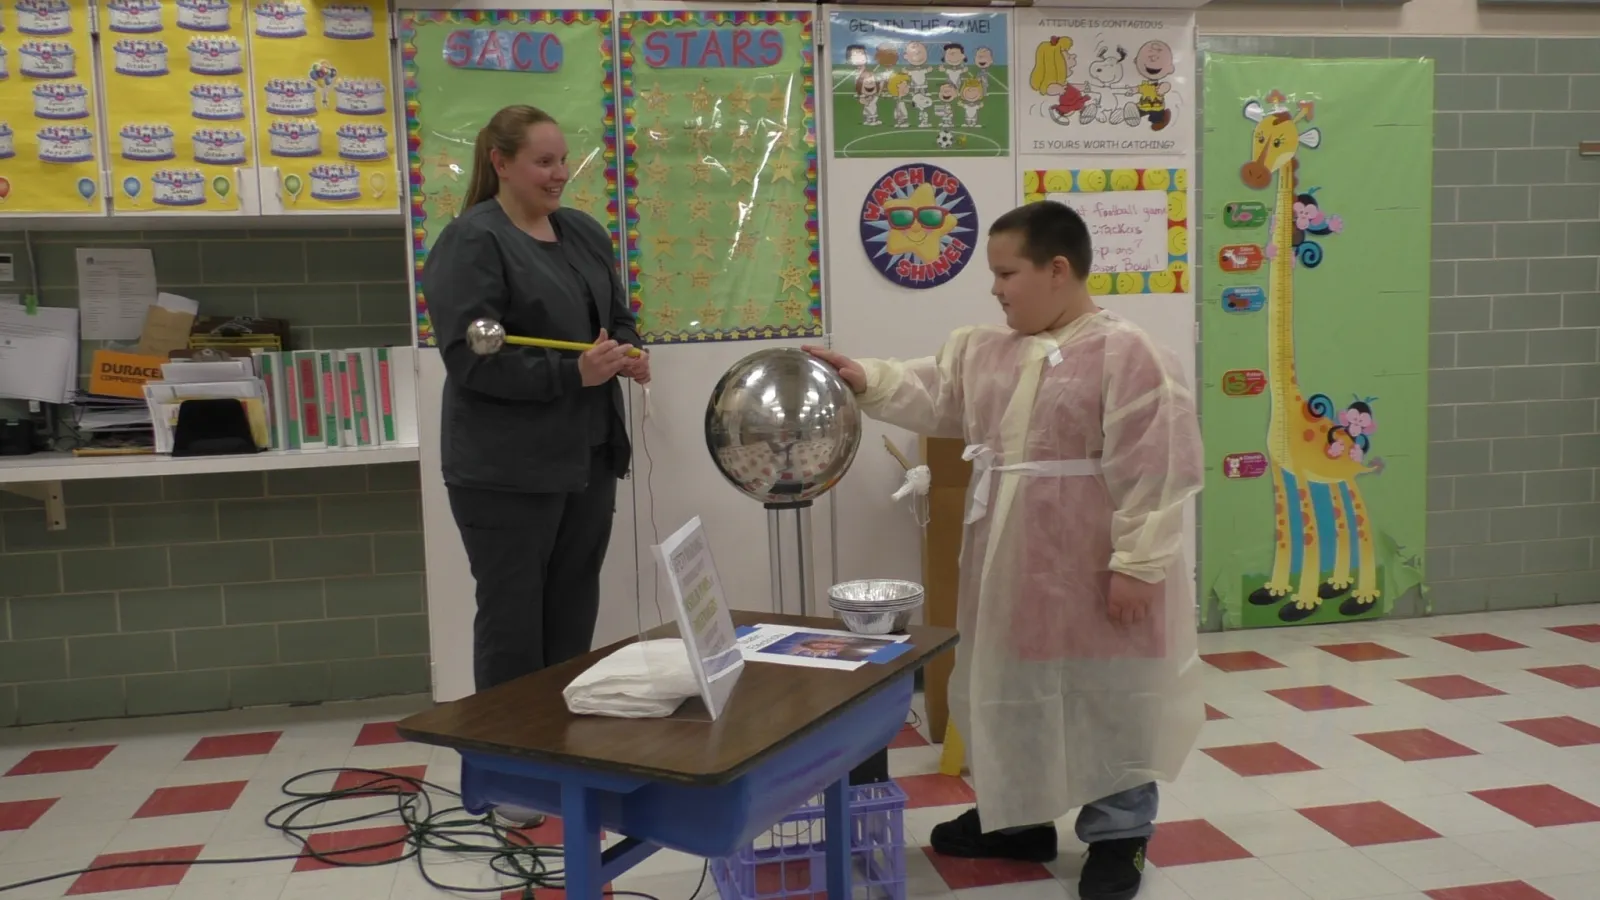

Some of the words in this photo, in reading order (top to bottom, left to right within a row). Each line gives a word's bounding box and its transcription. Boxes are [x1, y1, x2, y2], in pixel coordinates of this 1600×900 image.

[849, 19, 877, 32] GET
[884, 19, 904, 31] IN
[910, 19, 940, 32] THE
[947, 19, 991, 34] GAME!
[1039, 18, 1086, 28] ATTITUDE
[1088, 19, 1100, 28] IS
[1101, 19, 1164, 30] CONTAGIOUS
[446, 29, 561, 71] SACC
[644, 29, 784, 68] STARS
[1033, 140, 1045, 149] IS
[1048, 140, 1080, 149] YOURS
[1083, 140, 1119, 149] WORTH
[1121, 140, 1175, 150] CATCHING?
[863, 167, 925, 221] WATCH
[931, 170, 959, 195] US
[1093, 201, 1138, 218] football
[896, 237, 967, 281] SHINE!
